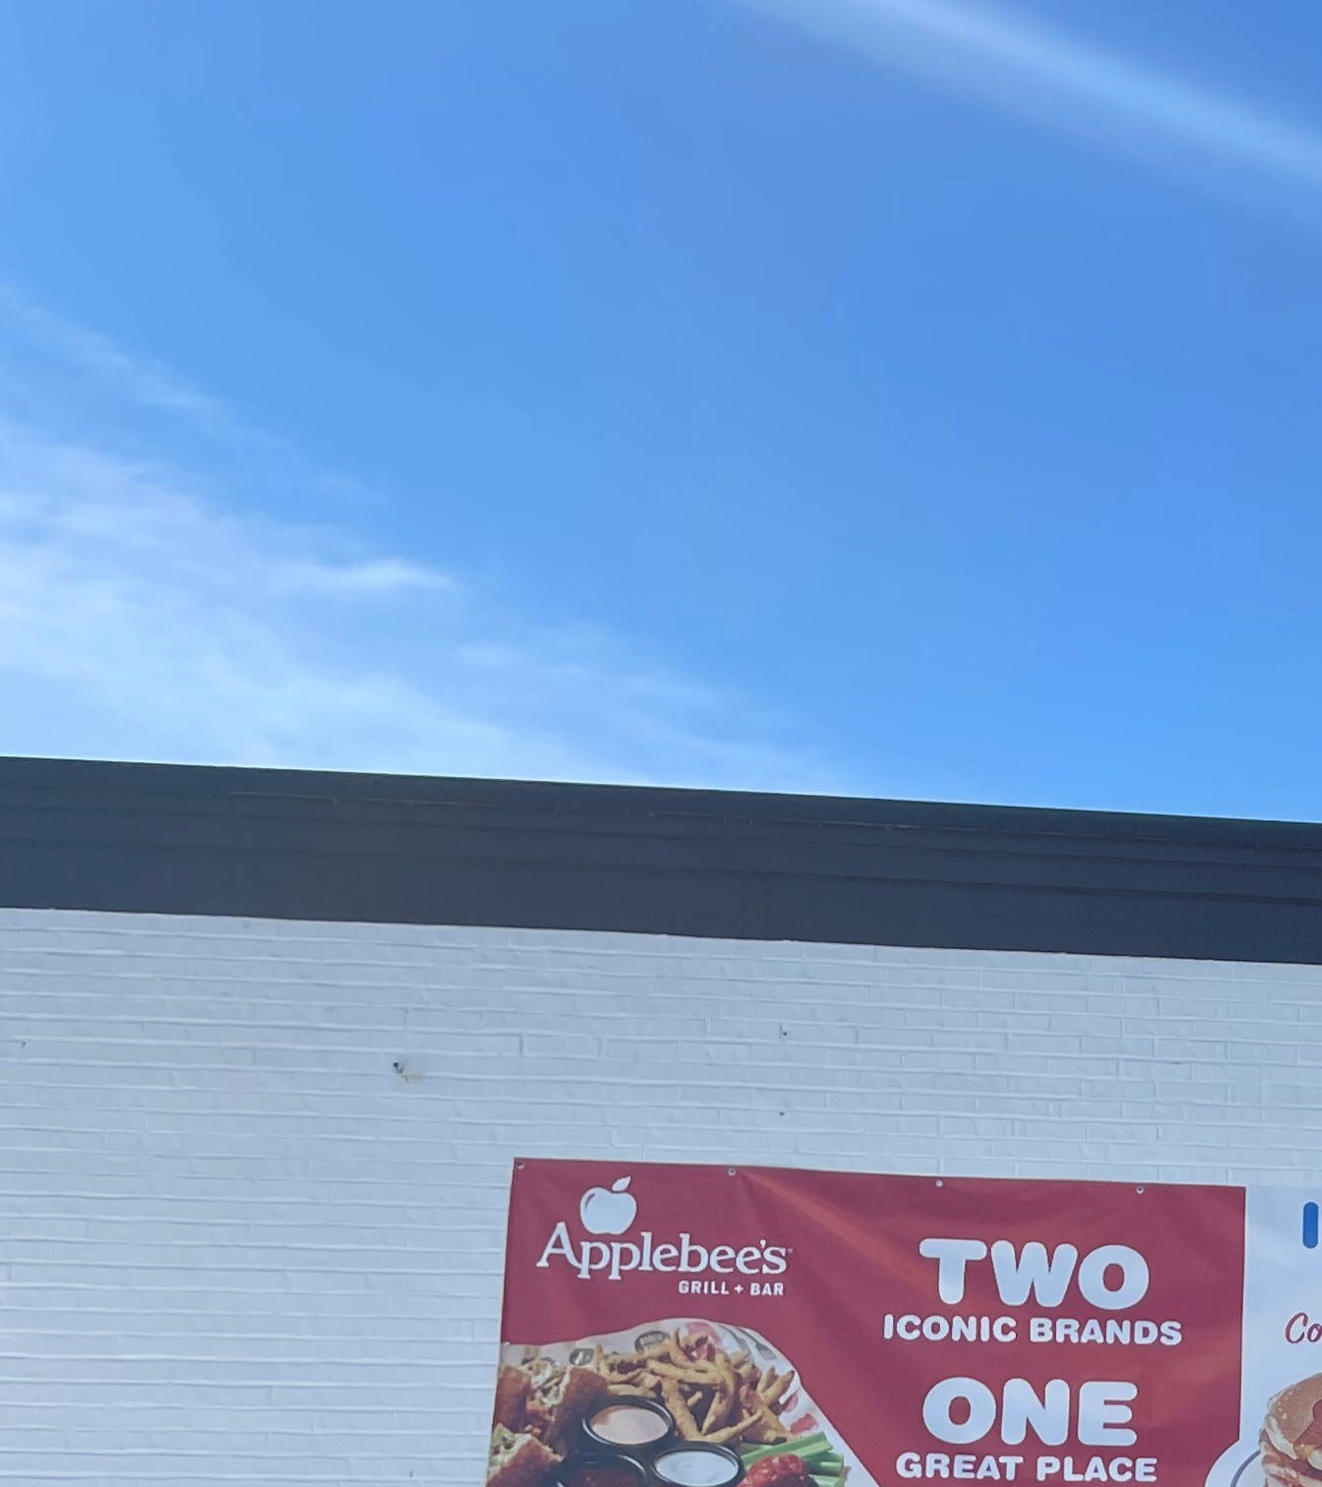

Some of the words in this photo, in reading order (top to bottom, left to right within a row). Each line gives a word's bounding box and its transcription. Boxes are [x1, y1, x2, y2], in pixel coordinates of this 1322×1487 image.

[535, 1220, 788, 1281] Applebee's
[918, 1237, 1150, 1311] TWO
[678, 1279, 730, 1296] GRILL
[749, 1281, 785, 1297] BAR
[883, 1313, 1018, 1343] ICONIC
[1029, 1316, 1183, 1346] BRANDS
[921, 1376, 1139, 1447] ONE
[896, 1451, 1024, 1480] GREAT
[1036, 1455, 1158, 1483] PLACE
